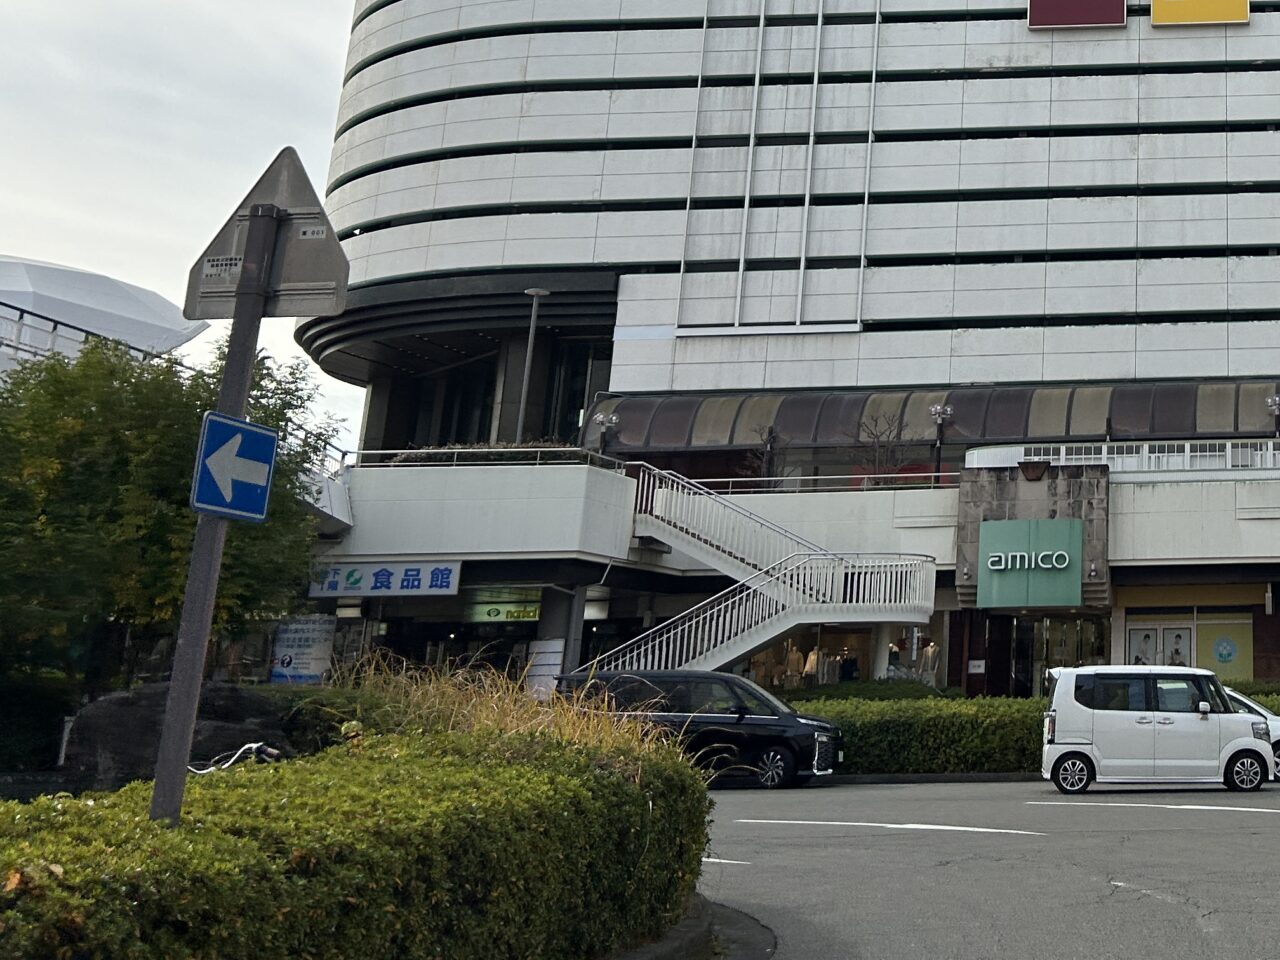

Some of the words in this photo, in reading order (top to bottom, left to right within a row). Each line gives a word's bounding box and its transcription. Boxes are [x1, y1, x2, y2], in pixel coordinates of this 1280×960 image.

[987, 550, 1069, 570] amico
[370, 567, 453, 591] 食品館
